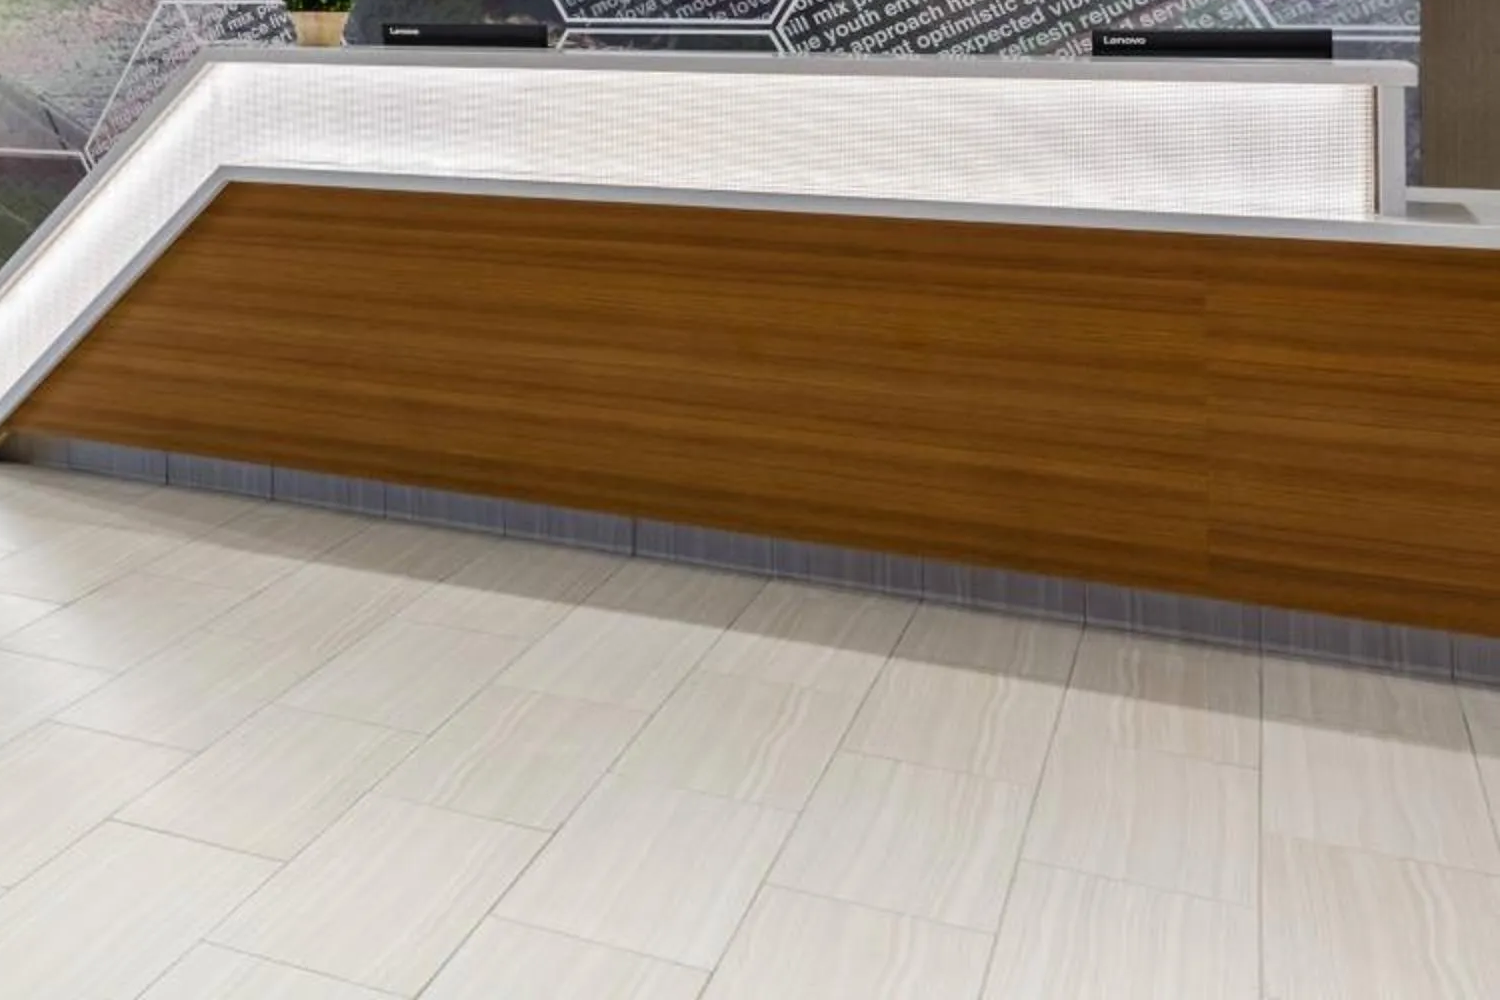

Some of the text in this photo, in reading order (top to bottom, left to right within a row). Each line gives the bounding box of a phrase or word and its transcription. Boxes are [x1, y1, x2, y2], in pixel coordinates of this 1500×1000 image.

[822, 4, 882, 46] youth
[848, 0, 944, 54] approach
[1103, 35, 1147, 45] Lenovo
